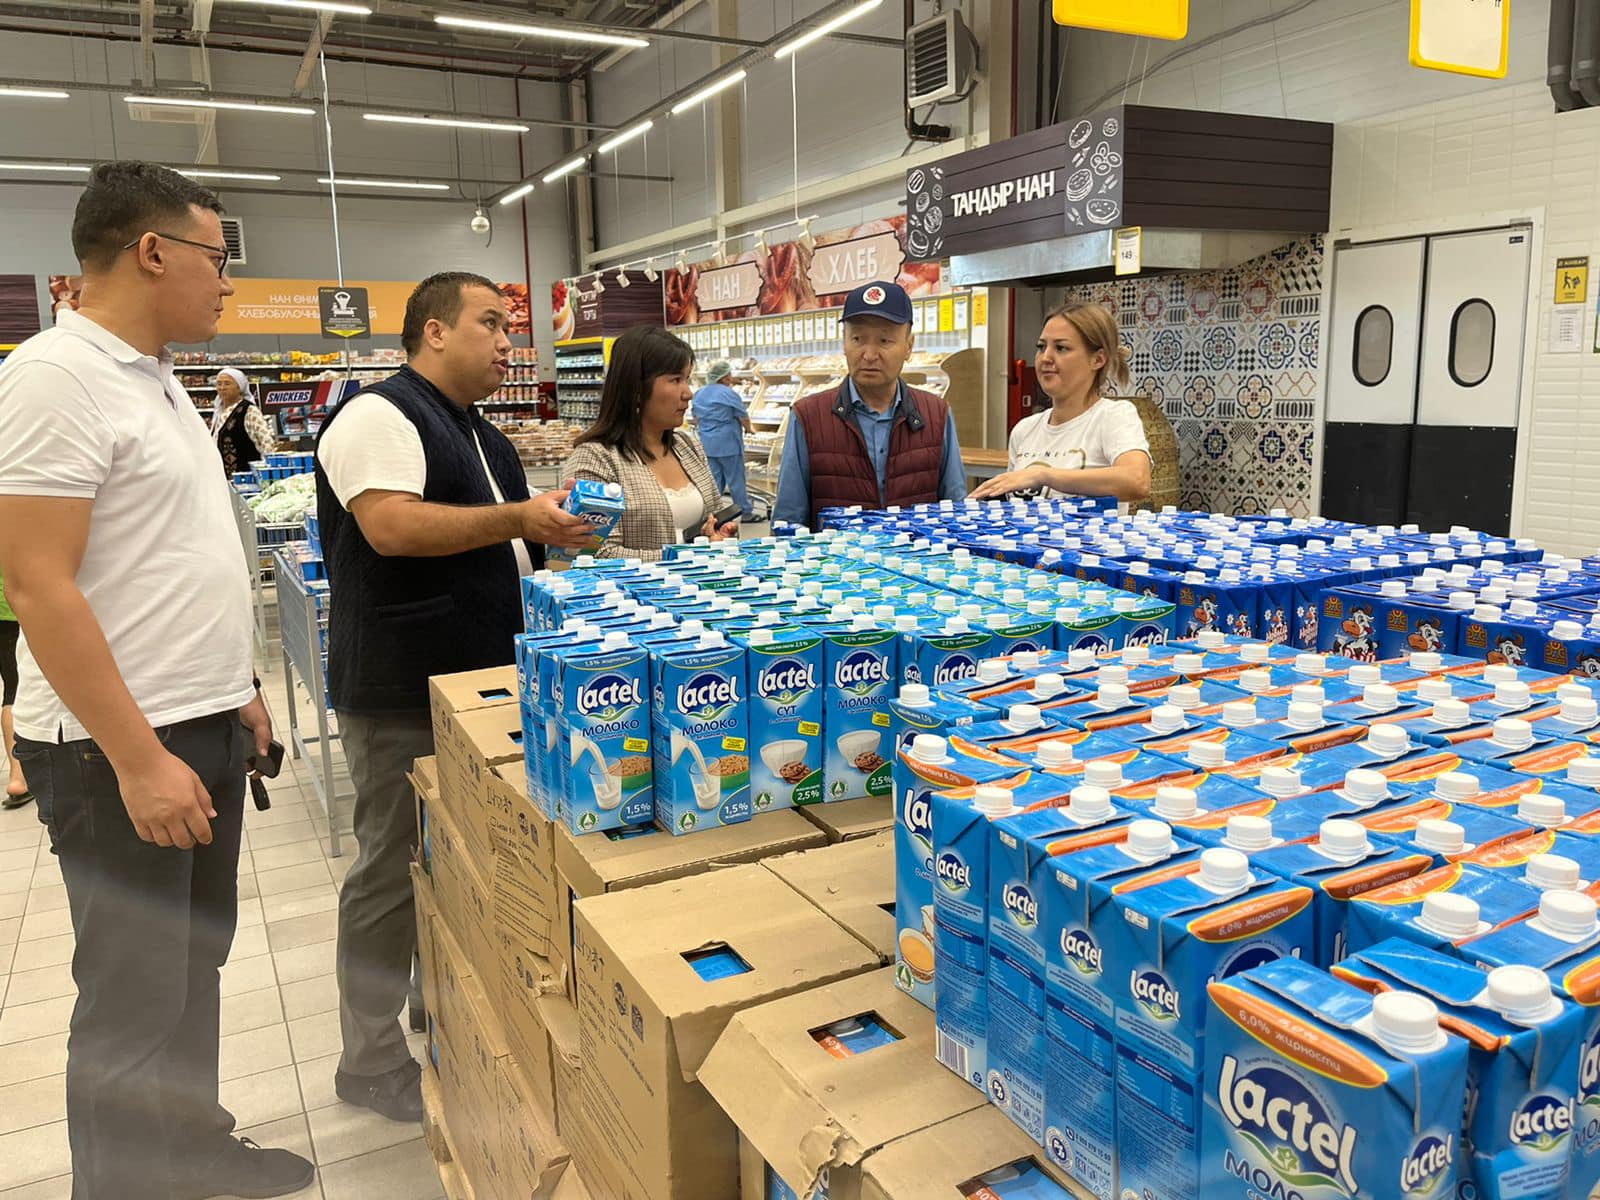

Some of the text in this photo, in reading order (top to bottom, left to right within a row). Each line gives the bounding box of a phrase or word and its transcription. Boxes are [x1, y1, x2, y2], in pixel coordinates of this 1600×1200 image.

[951, 171, 1055, 217] ТАНДЫР НАН
[829, 247, 878, 284] ХЛЕБ
[712, 273, 740, 300] НАН
[269, 295, 291, 304] НАН
[268, 391, 310, 402] SNICKERS
[838, 695, 887, 709] МОЛОКО
[583, 720, 640, 736] МОЛОКО
[683, 719, 737, 736] МОЛОКО
[797, 789, 820, 801] 2,5%
[626, 802, 651, 814] 1,5%
[724, 801, 748, 815] 1,5%
[1238, 1008, 1342, 1073] 6,0% жирности
[1218, 1055, 1358, 1194] lactel
